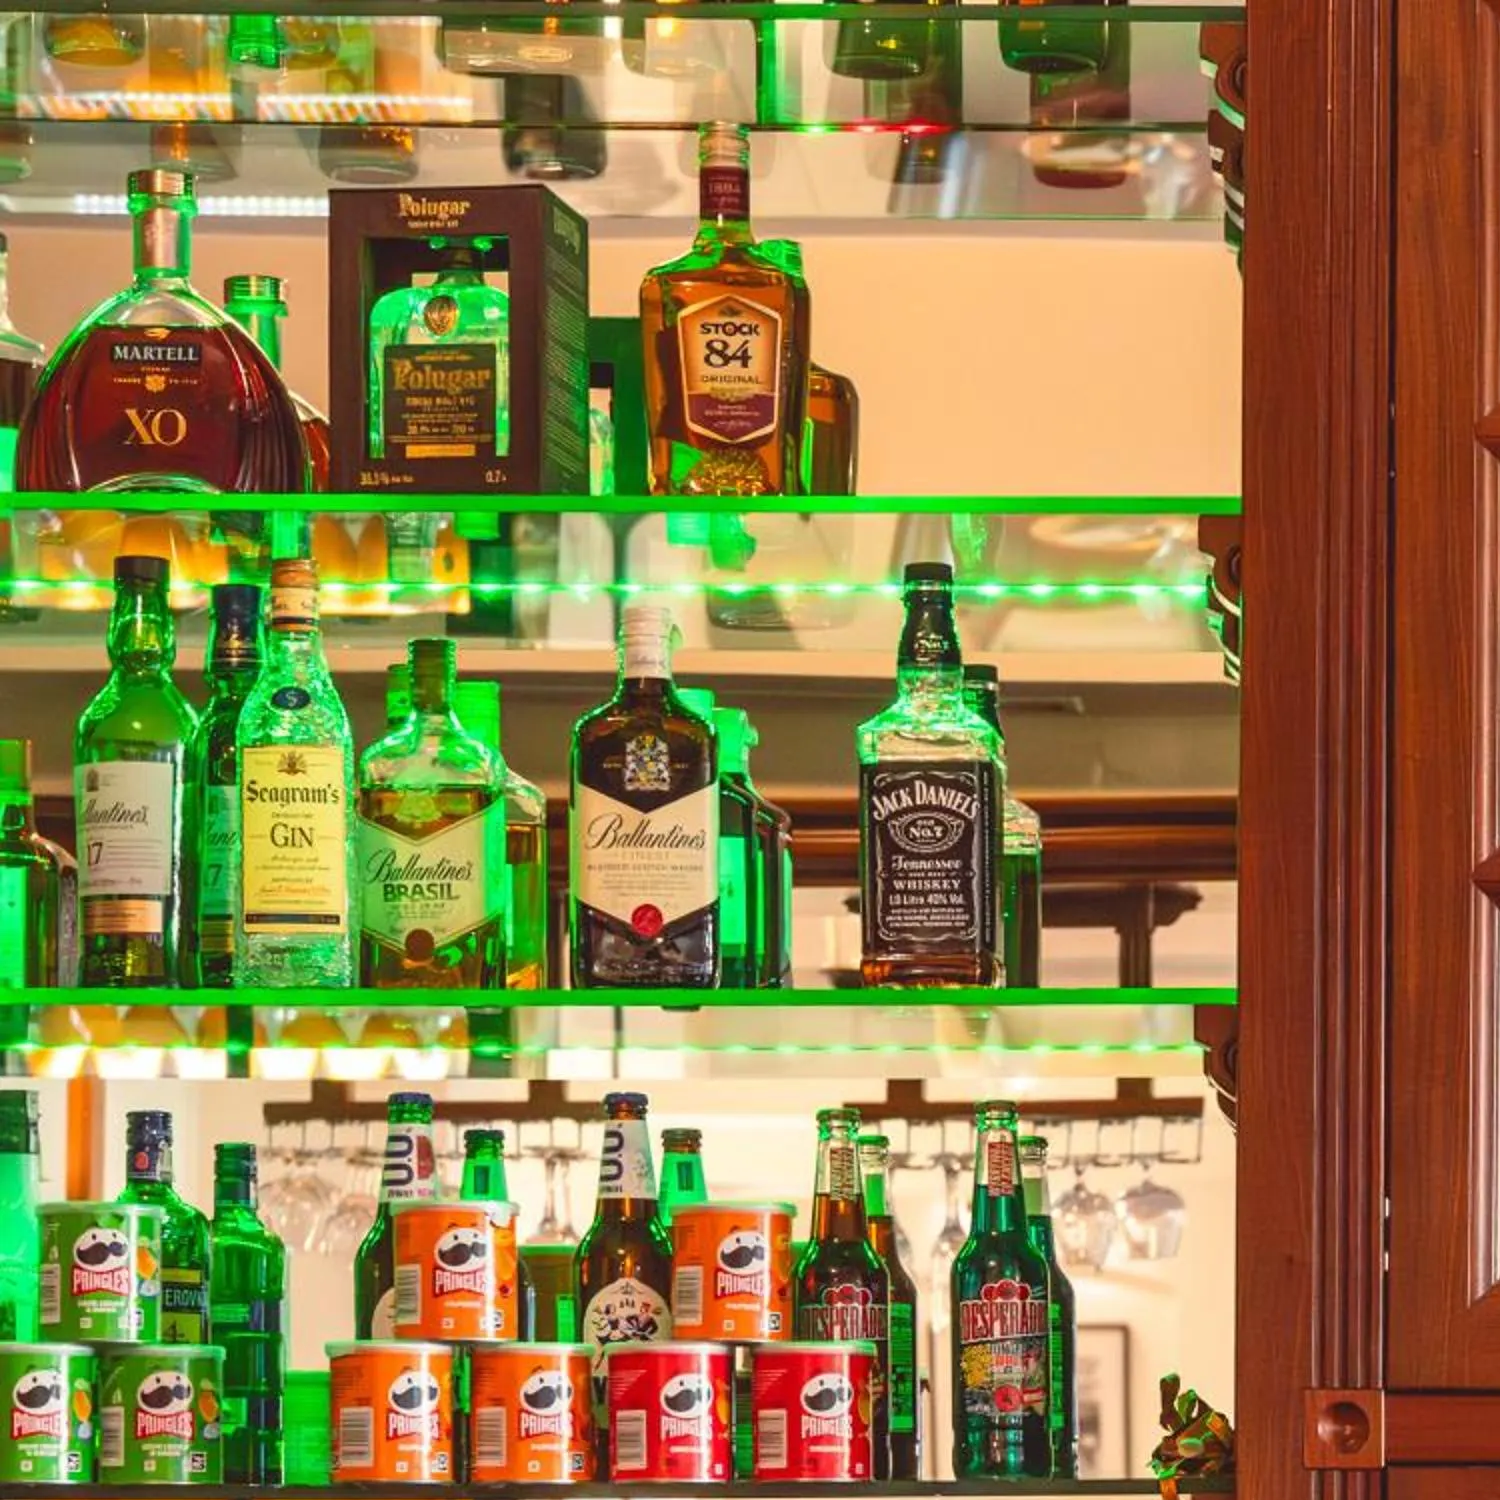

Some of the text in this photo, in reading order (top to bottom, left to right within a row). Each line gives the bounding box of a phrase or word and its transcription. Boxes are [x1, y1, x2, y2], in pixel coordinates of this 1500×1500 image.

[398, 192, 471, 220] Polugar
[700, 322, 760, 337] STOCK
[113, 345, 200, 361] MARTELL
[703, 338, 752, 369] 84
[391, 357, 491, 395] Polugar
[123, 408, 188, 447] XO
[246, 779, 340, 808] Seagram's
[872, 780, 981, 821] JACK DANIEL'S
[270, 821, 316, 849] GIN
[584, 811, 708, 851] Ballantine's
[365, 847, 474, 886] Ballantine's
[383, 882, 461, 903] BRASIL
[893, 879, 962, 891] WHISKEY
[73, 1267, 130, 1297] PRINGLES
[435, 1270, 490, 1296] PRINGLE
[716, 1271, 769, 1297] PRINGLE
[137, 1410, 194, 1438] PRINGLES
